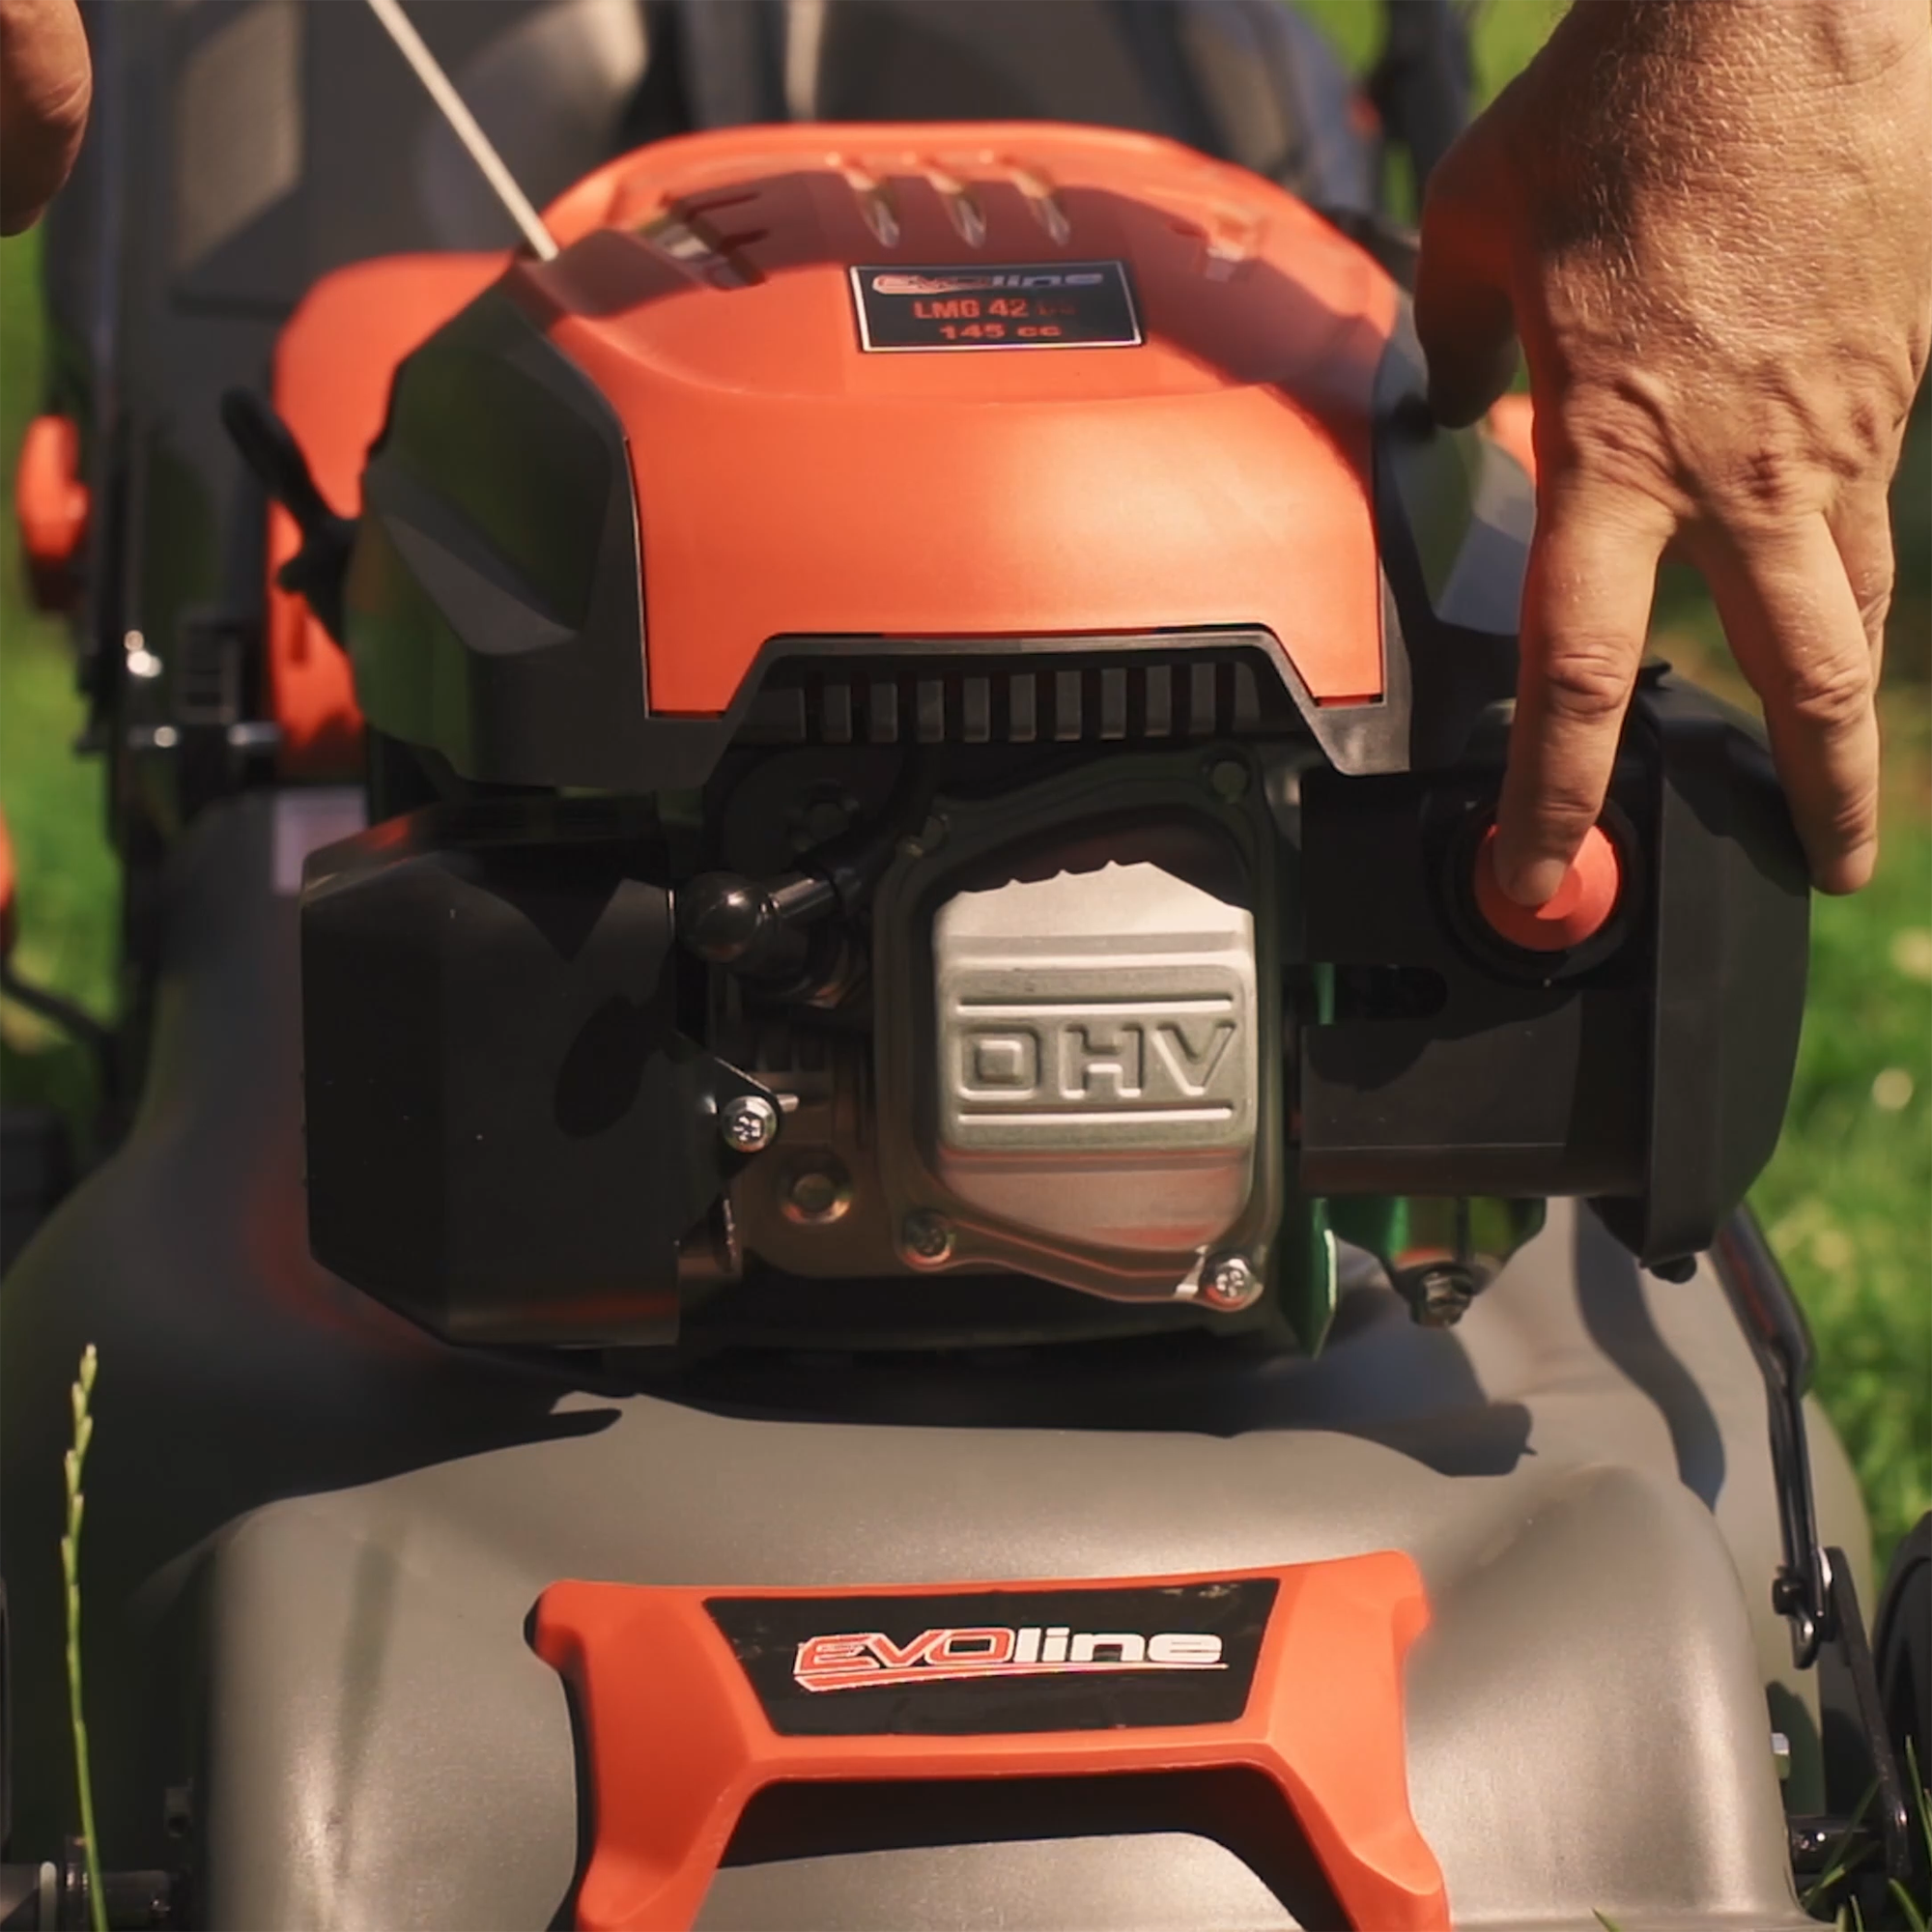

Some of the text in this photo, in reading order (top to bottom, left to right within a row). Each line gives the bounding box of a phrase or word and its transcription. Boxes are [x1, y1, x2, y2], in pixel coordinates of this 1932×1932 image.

[988, 299, 1029, 317] 42
[940, 325, 1005, 339] 145
[958, 1022, 1236, 1100] OHV
[794, 1627, 1222, 1676] EVOline
